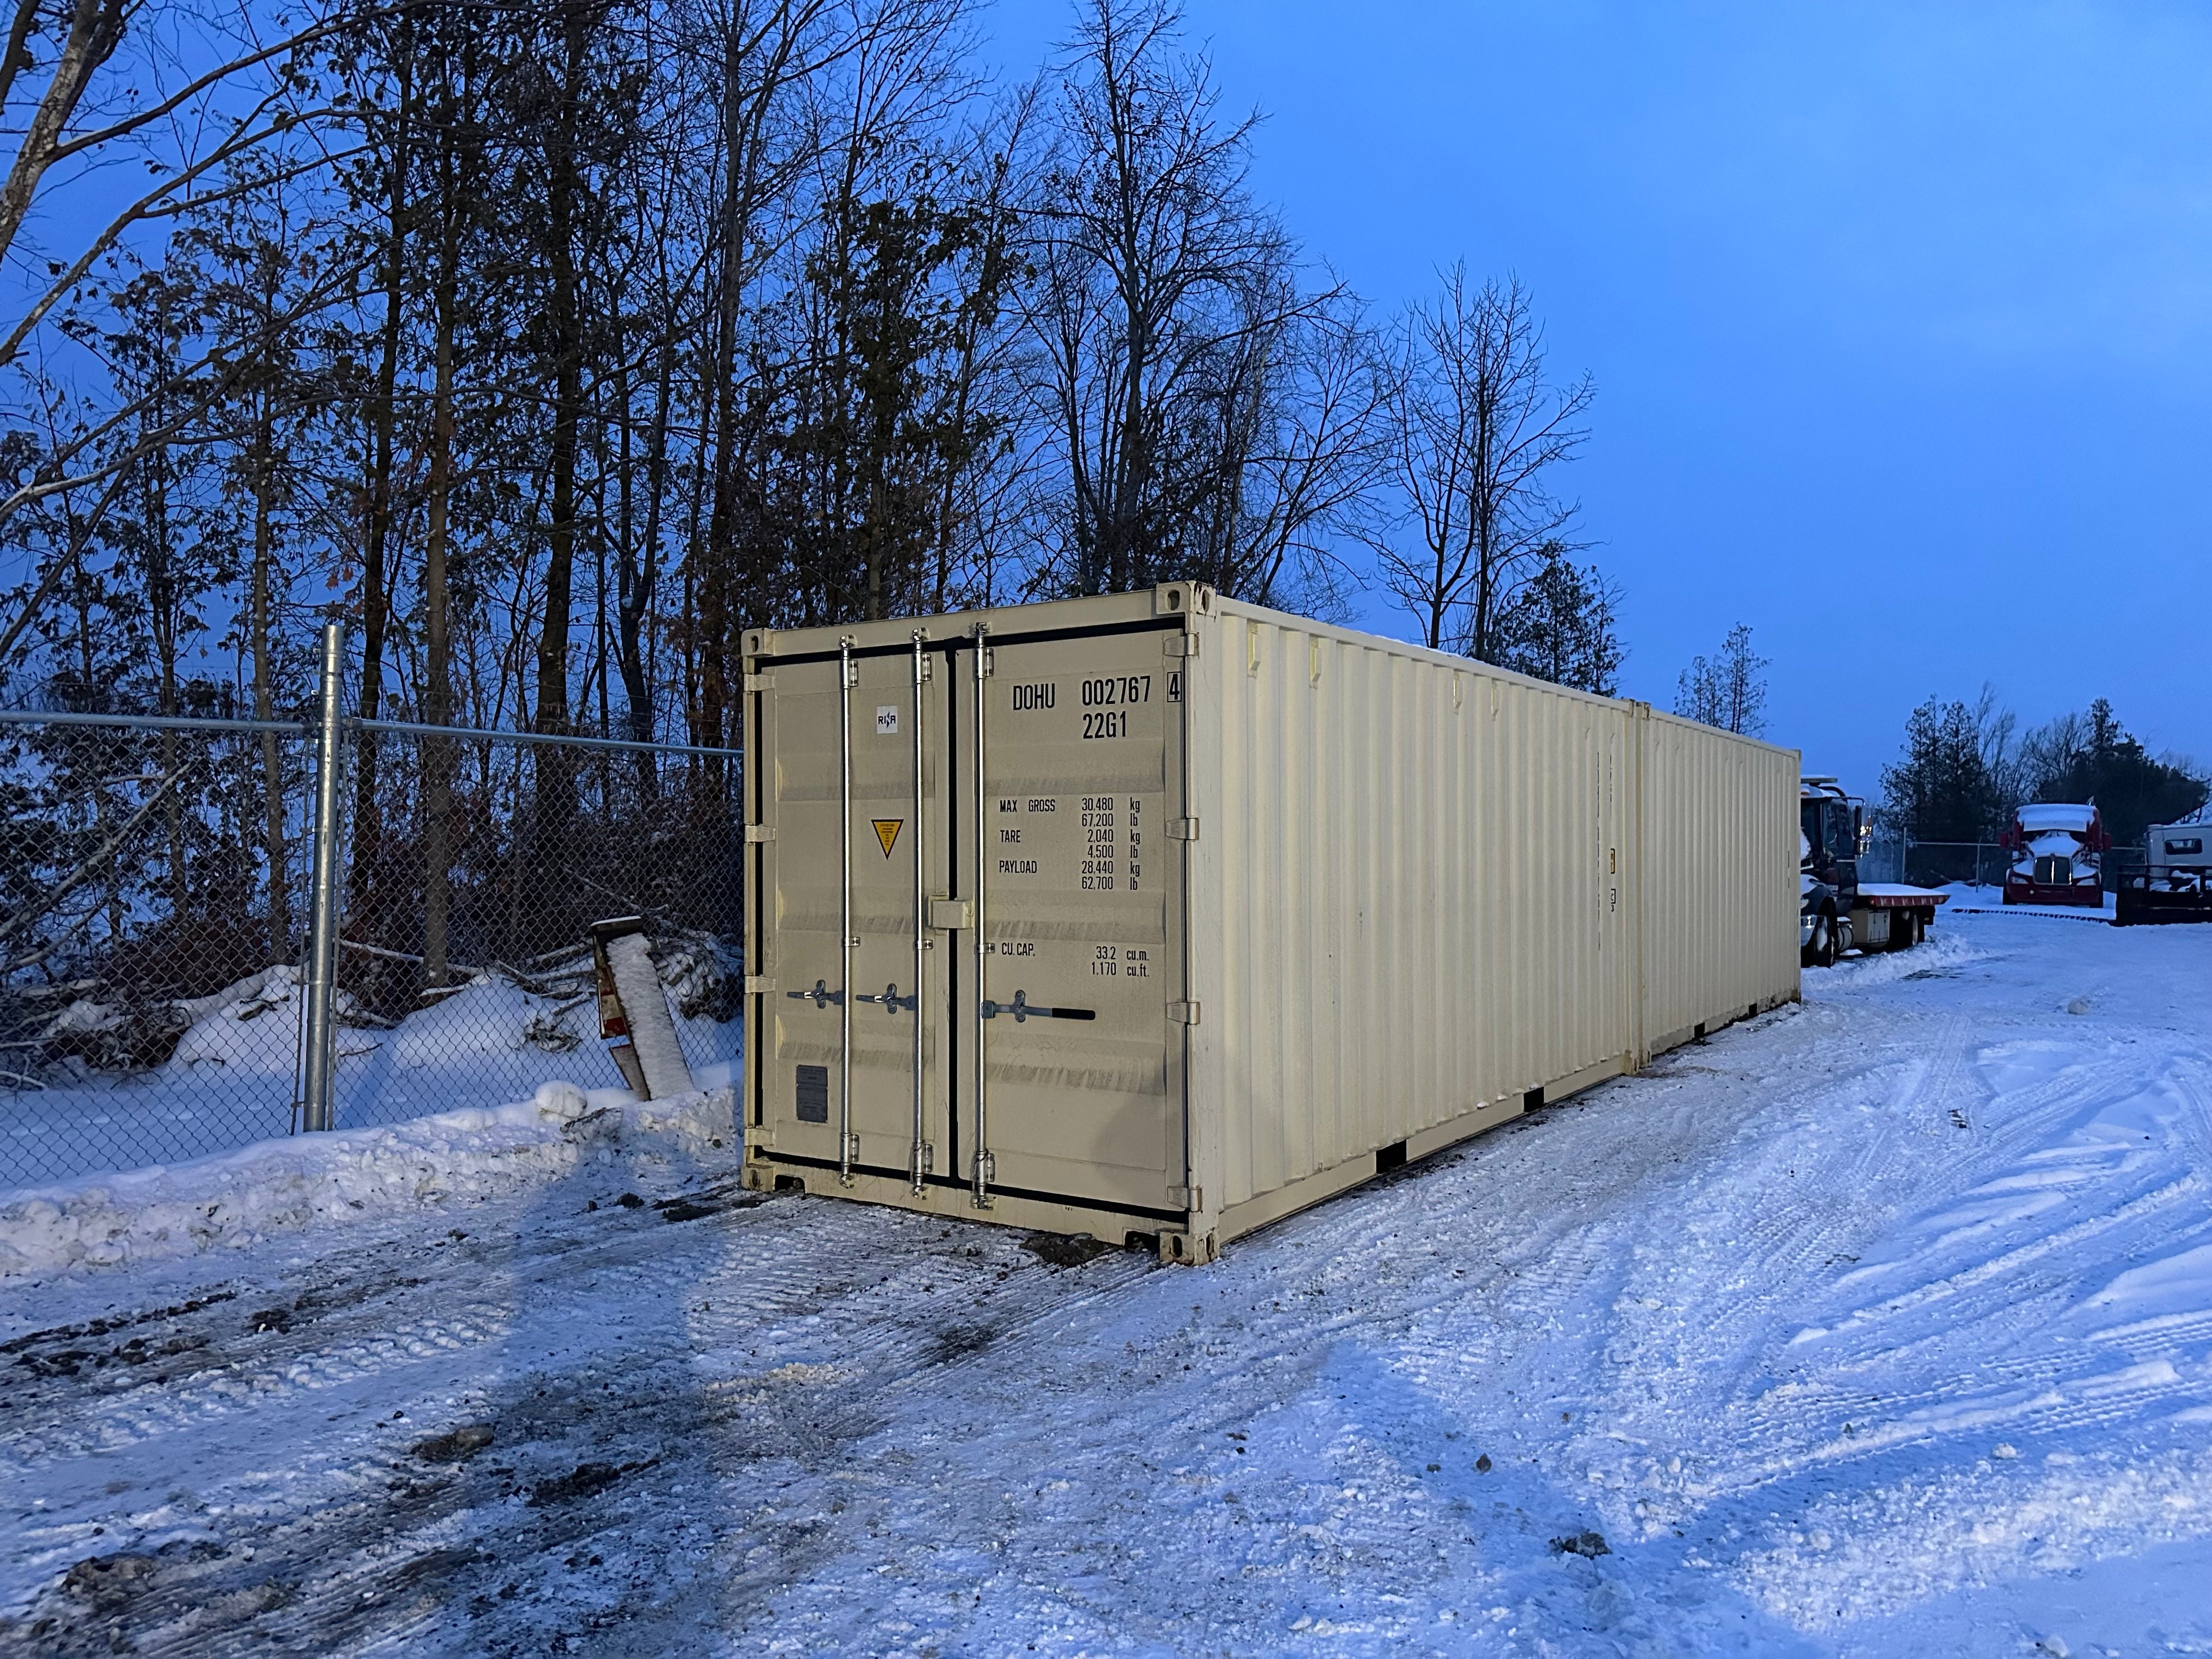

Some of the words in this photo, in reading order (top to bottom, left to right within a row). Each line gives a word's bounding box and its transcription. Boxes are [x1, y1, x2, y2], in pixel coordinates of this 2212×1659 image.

[1013, 683, 1055, 711] DOHU
[1082, 675, 1151, 706] 002767
[1169, 673, 1180, 700] 4
[1082, 711, 1126, 739] 22G1
[999, 799, 1018, 813] MAX
[1028, 798, 1056, 812] GROSS
[1130, 797, 1141, 813] kg
[1130, 812, 1138, 827] lb
[999, 830, 1021, 843] TARE
[1130, 828, 1141, 845] kg
[1130, 844, 1138, 858] lb
[999, 859, 1038, 873] PAYLOAD
[1130, 861, 1141, 877] kg
[1130, 876, 1138, 891] lb
[1096, 946, 1116, 960] 33.2
